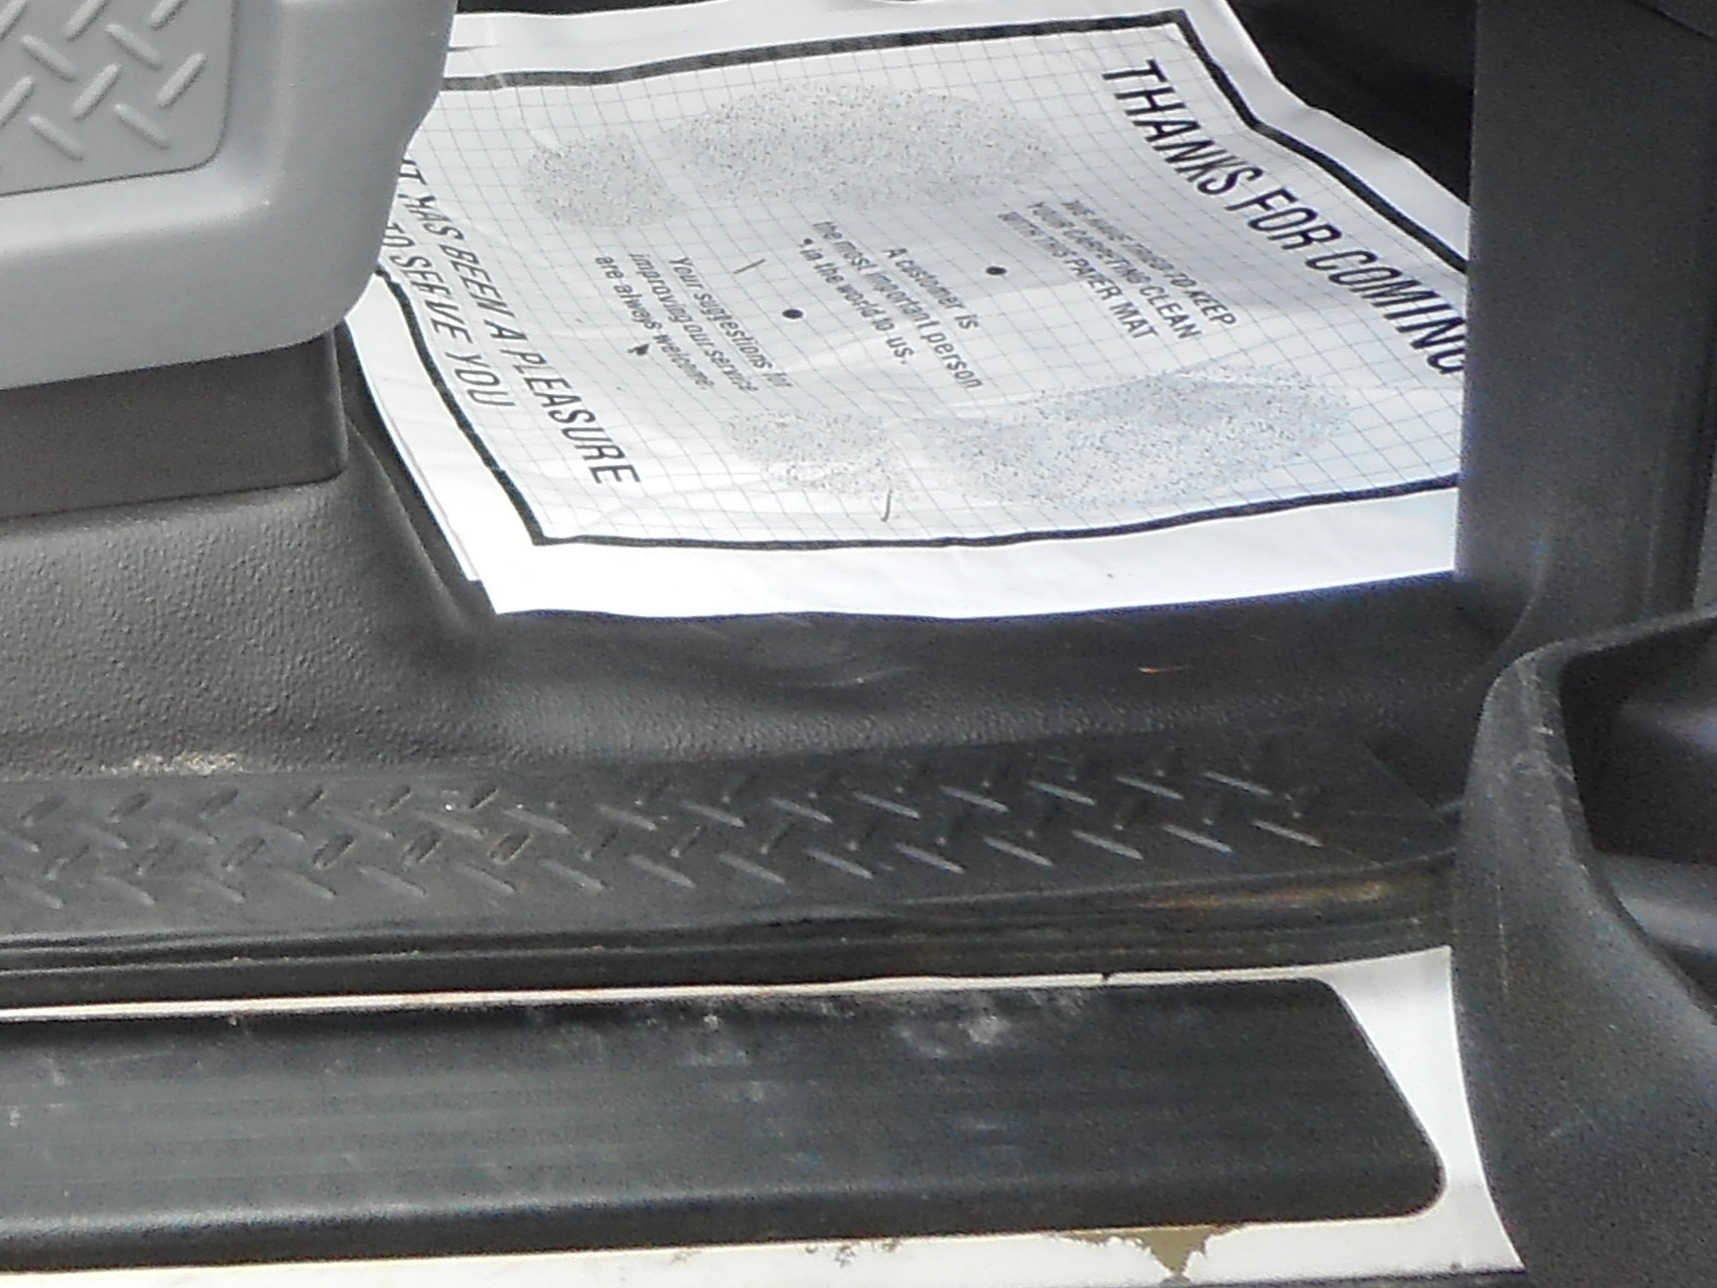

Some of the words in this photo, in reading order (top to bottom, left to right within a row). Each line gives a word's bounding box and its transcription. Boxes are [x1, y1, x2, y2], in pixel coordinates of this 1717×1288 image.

[1102, 59, 1264, 195] THANKS
[1225, 188, 1342, 250] FOR
[397, 195, 464, 240] HAS
[440, 243, 516, 318] BEEN
[595, 256, 624, 279] are
[613, 284, 663, 330] always
[669, 257, 704, 290] Your
[693, 292, 773, 371] suggestions
[814, 262, 844, 284] the
[836, 283, 886, 318] world
[871, 318, 895, 331] to
[886, 336, 914, 365] us.
[833, 240, 878, 271] most
[865, 272, 940, 330] important
[919, 332, 983, 389] person
[882, 248, 908, 259] A
[895, 259, 966, 309] customer
[954, 314, 979, 330] is
[1110, 301, 1159, 339] MAT
[1139, 285, 1202, 339] CLEAN
[1164, 272, 1196, 288] TO
[1185, 289, 1237, 326] KEEP
[389, 255, 474, 345] SERVE
[445, 351, 517, 409] YOU
[483, 319, 528, 342] A
[629, 253, 693, 323] improving
[683, 324, 714, 348] our
[704, 349, 759, 392] service
[500, 347, 641, 484] PLEASURE
